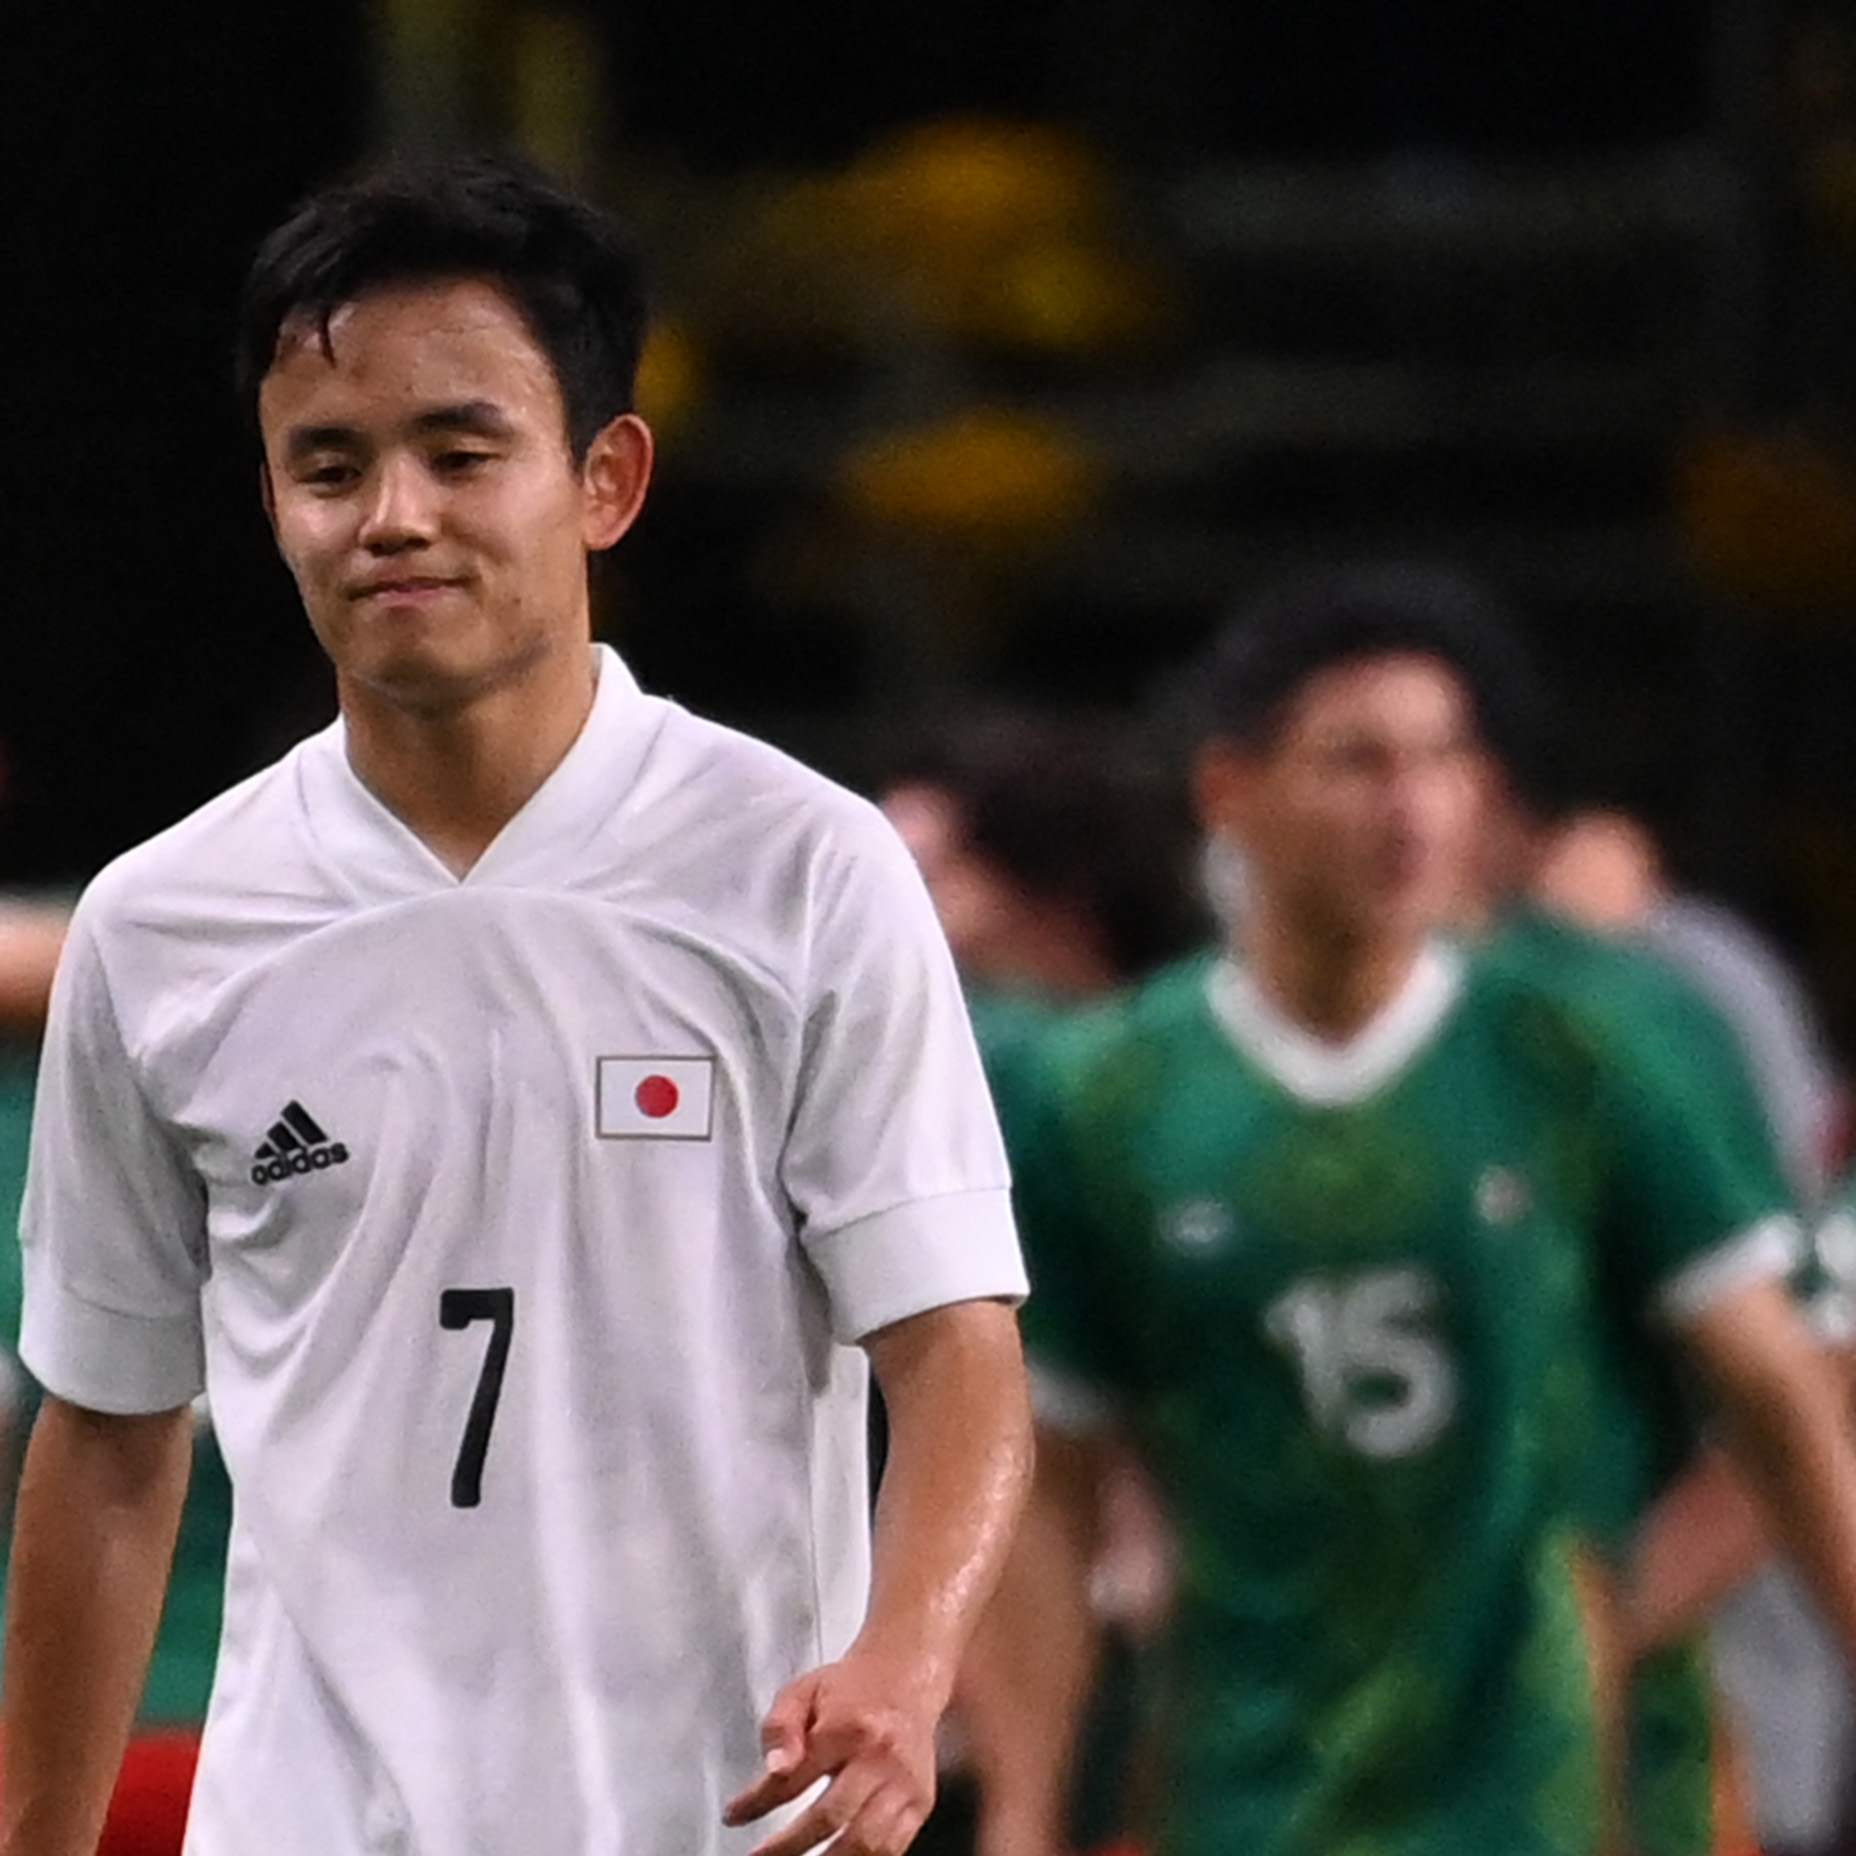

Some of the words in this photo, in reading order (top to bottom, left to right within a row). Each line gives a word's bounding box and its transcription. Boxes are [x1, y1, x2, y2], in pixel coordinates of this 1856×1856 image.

[251, 1142, 349, 1186] adidas
[440, 1287, 514, 1509] 7
[1264, 1267, 1457, 1461] 15
